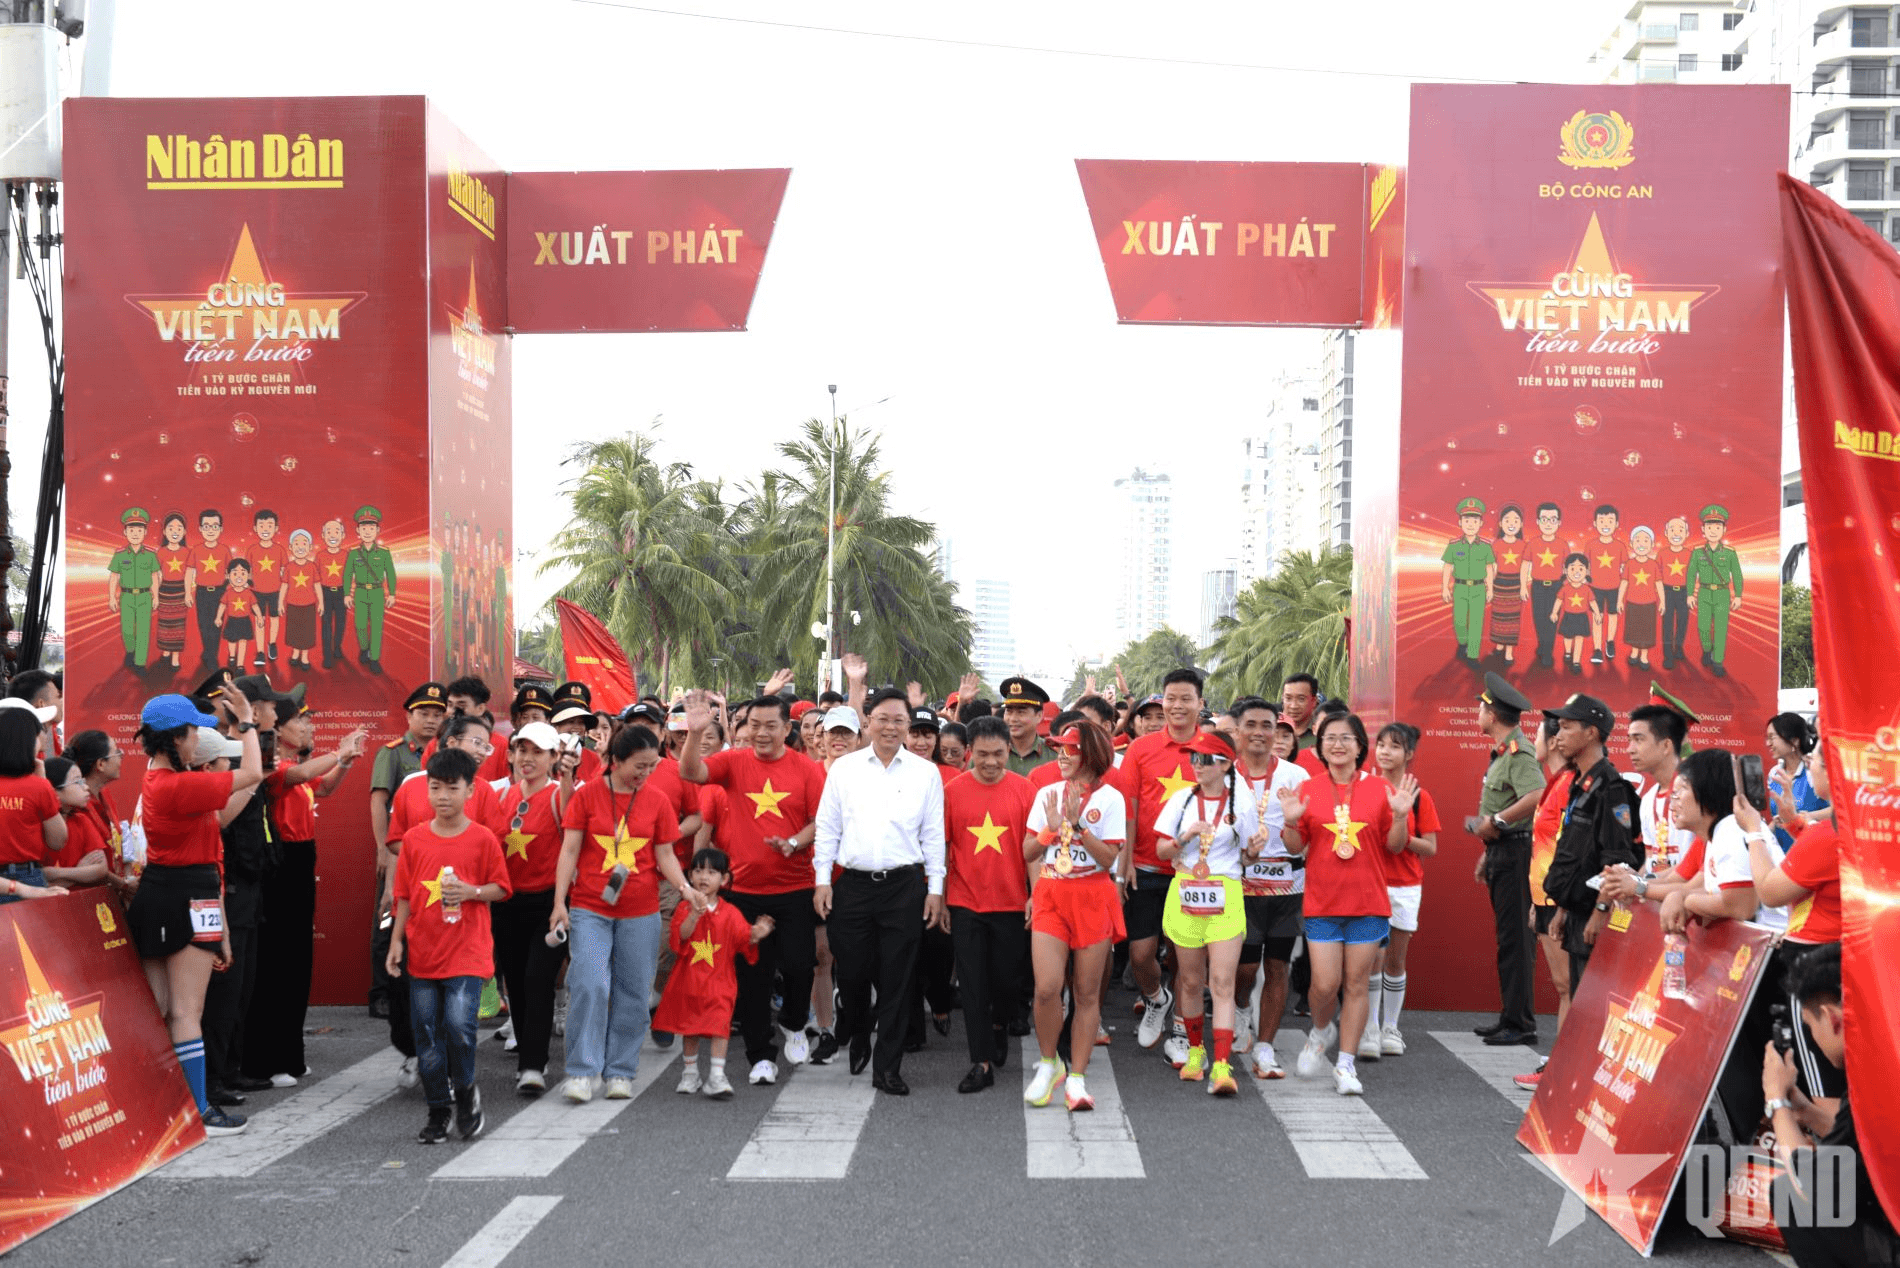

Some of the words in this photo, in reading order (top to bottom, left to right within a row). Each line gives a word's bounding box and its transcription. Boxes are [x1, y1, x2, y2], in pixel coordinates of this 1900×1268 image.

[146, 133, 256, 179] Nhân
[262, 133, 344, 179] Dân
[1539, 181, 1565, 200] BỘ
[1570, 182, 1621, 199] CÔNG
[1627, 185, 1653, 199] AN
[533, 223, 633, 266] XUẤT
[647, 223, 743, 265] PHÁT
[1121, 214, 1223, 257] XUẤT
[1237, 216, 1336, 258] PHÁT
[207, 275, 285, 308] CÙNG
[1552, 265, 1634, 298] CÙNG
[153, 302, 243, 346] VIỆT
[253, 308, 340, 341] NAM
[1495, 291, 1588, 337] VIỆT
[1599, 300, 1691, 334] NAM
[183, 336, 238, 362] tiến
[243, 334, 313, 362] bước
[1525, 327, 1582, 353] tiến
[1588, 325, 1661, 355] bước
[202, 374, 209, 384] 1
[261, 373, 291, 384] CHÂN
[1544, 366, 1550, 376] 1
[1605, 364, 1637, 376] CHÂN
[1591, 377, 1636, 389] NGUYÊN
[248, 385, 291, 396] NGUYÊN
[1184, 891, 1217, 904] 0818
[25, 989, 71, 1030] CÙNG
[6, 1025, 64, 1082] VIỆT
[59, 1014, 112, 1064] NAM
